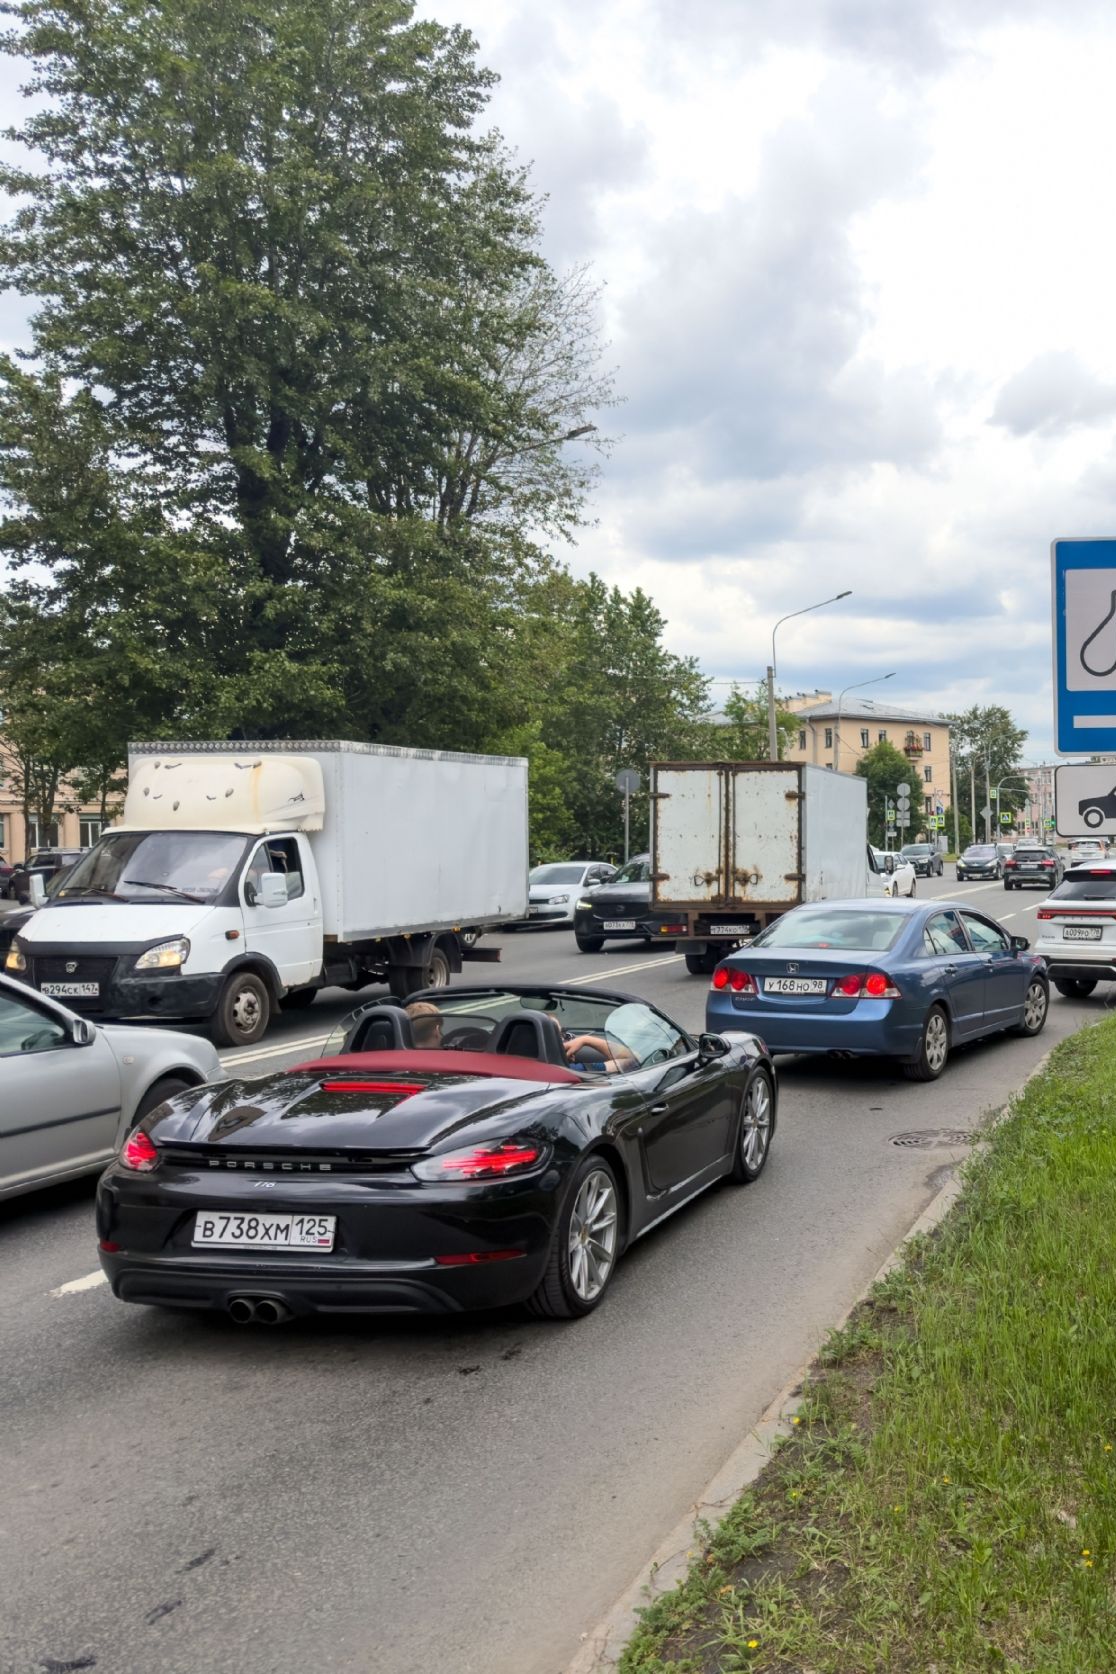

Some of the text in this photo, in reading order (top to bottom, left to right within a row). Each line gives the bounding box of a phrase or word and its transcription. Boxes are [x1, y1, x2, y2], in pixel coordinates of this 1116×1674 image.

[812, 980, 823, 990] 98
[209, 1160, 332, 1171] PORSCHE
[202, 1216, 329, 1242] В738ХМ 125
